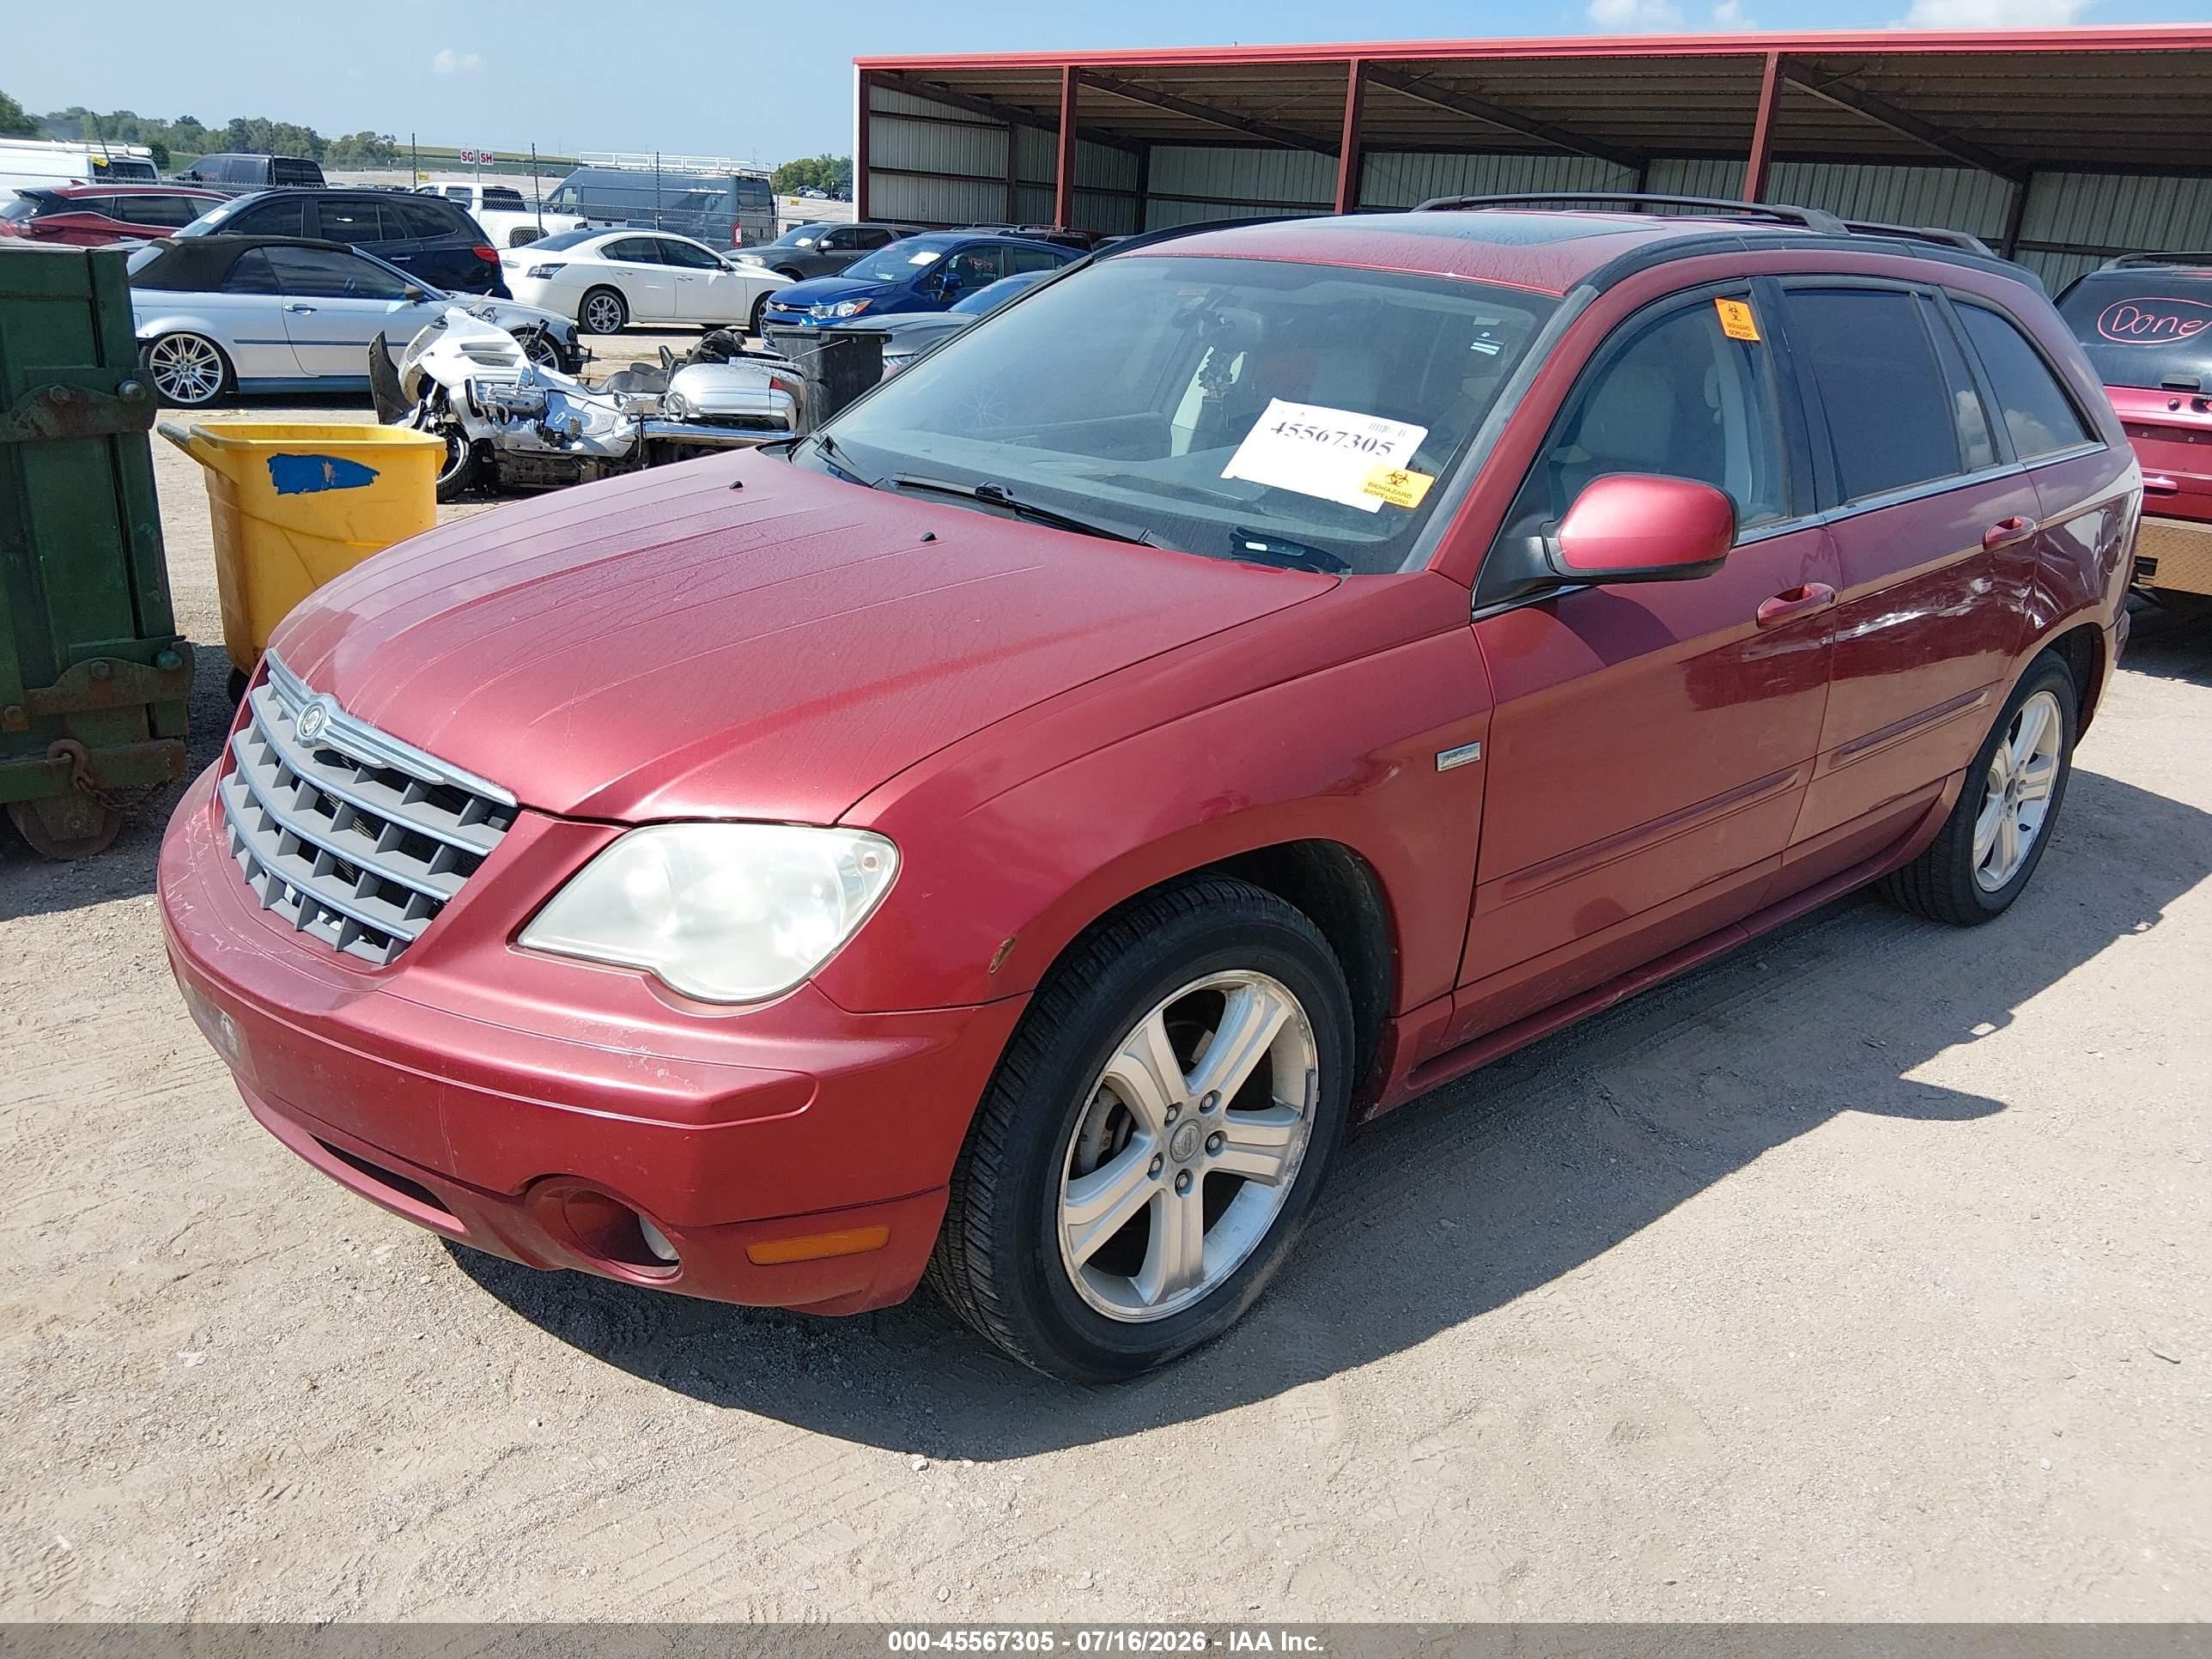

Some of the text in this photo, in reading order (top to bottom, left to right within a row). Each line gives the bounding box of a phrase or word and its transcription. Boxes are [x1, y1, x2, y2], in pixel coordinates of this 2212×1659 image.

[461, 150, 474, 162] SG
[480, 152, 493, 164] SH
[2112, 306, 2204, 336] Done
[1270, 421, 1395, 456] 45567305
[1363, 488, 1408, 505] BIOPELIGRO
[1367, 481, 1413, 499] BIOHAZARD
